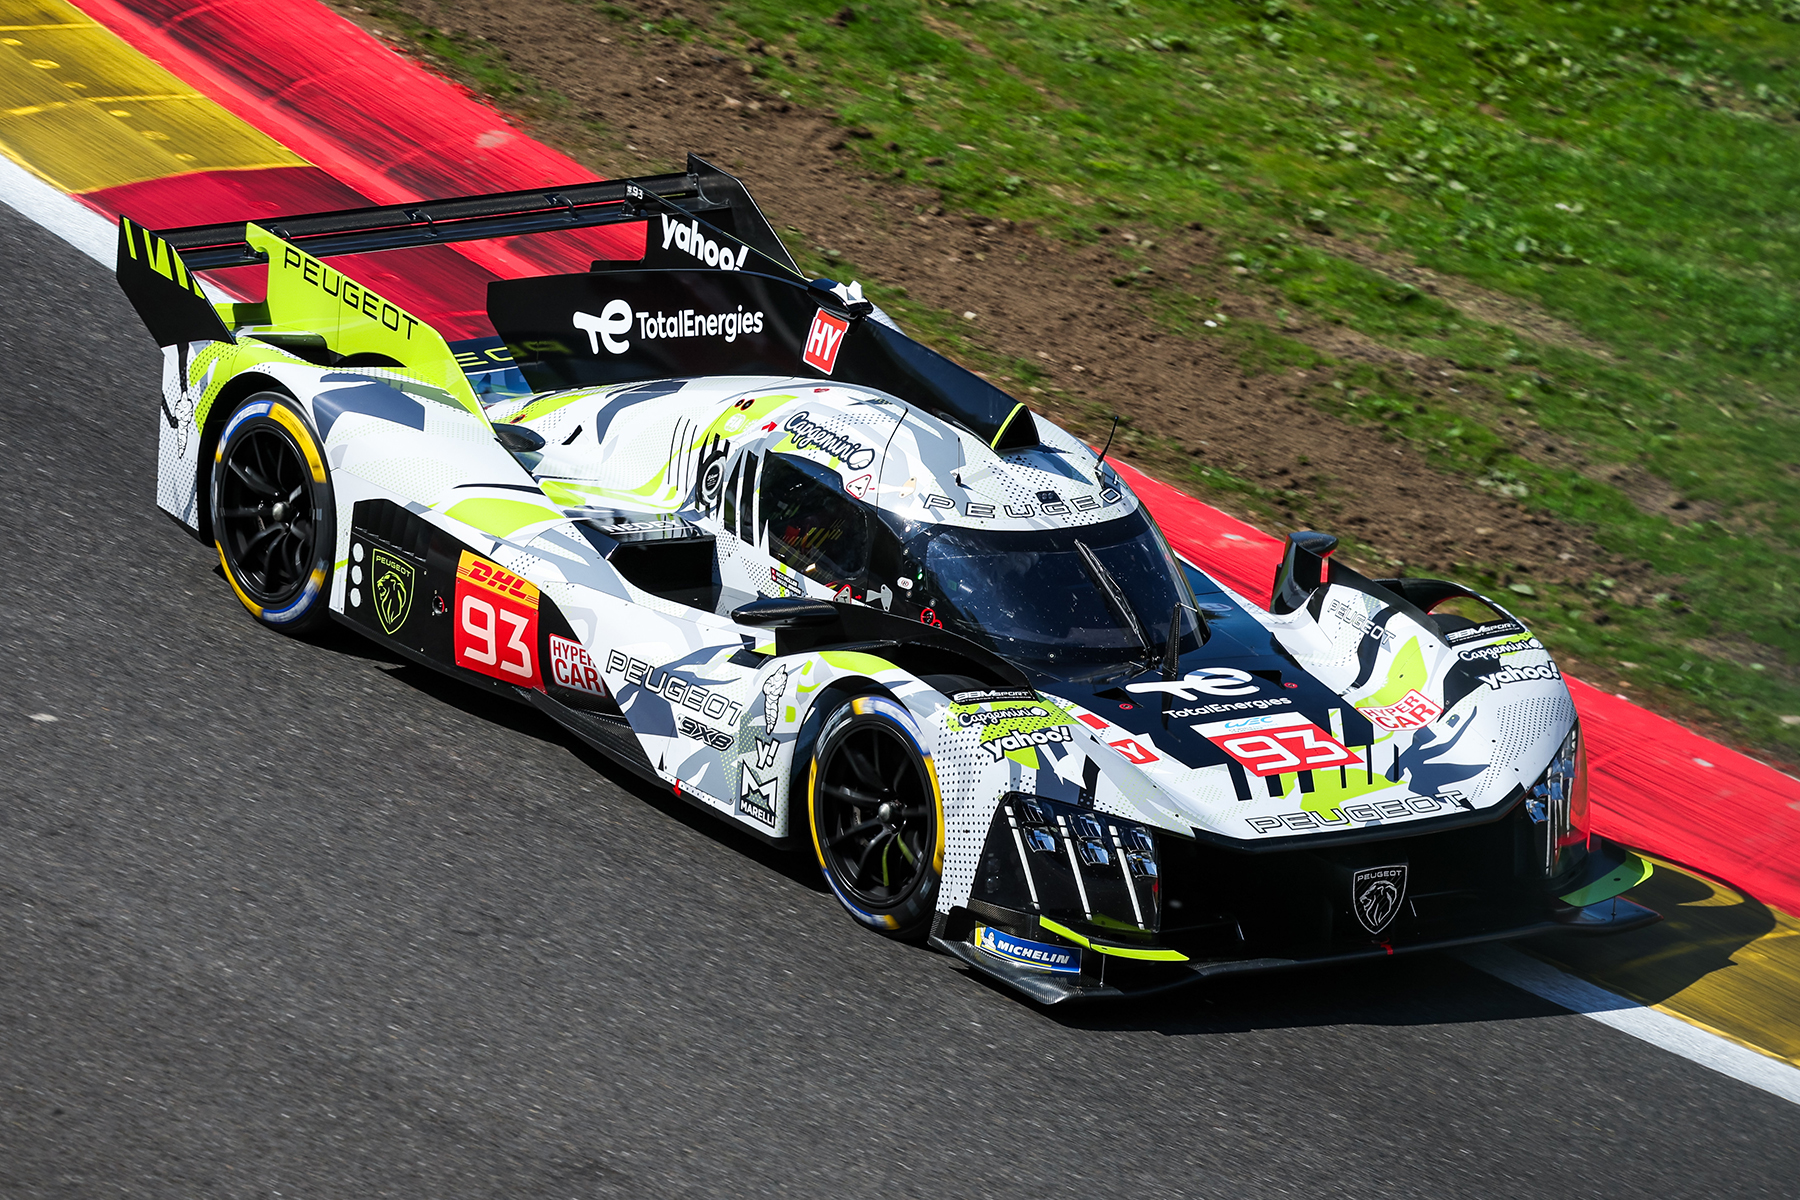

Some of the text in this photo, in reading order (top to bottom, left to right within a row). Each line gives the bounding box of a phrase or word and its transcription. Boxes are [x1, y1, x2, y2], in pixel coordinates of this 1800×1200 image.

[626, 184, 643, 200] #93
[661, 212, 749, 271] yahoo!
[285, 247, 418, 340] PEUGEOT
[636, 305, 763, 343] TotalEnergies
[808, 319, 842, 362] HY
[785, 411, 861, 462] Capgemini
[376, 555, 411, 578] PEUGEOT
[468, 561, 527, 600] DHL
[462, 595, 533, 678] 93
[1327, 599, 1396, 645] PEUGEOT
[1460, 640, 1530, 660] Capgemini
[555, 658, 602, 693] CAR
[605, 649, 743, 727] PEUGEOT
[1477, 661, 1560, 690] yahoo!
[959, 707, 1032, 725] Capgemini
[1162, 696, 1292, 720] TotalEnergies
[1224, 716, 1273, 729] WEC
[1360, 695, 1419, 717] HYPER
[1376, 703, 1436, 730] CAR
[680, 715, 734, 751] 9X8
[981, 726, 1073, 762] yahoo!
[1223, 729, 1349, 771] 93
[740, 799, 775, 826] MARELLI
[1246, 790, 1471, 833] PEUGEOT
[1357, 870, 1402, 882] PEUGEOT
[997, 941, 1070, 965] MICHELIN
